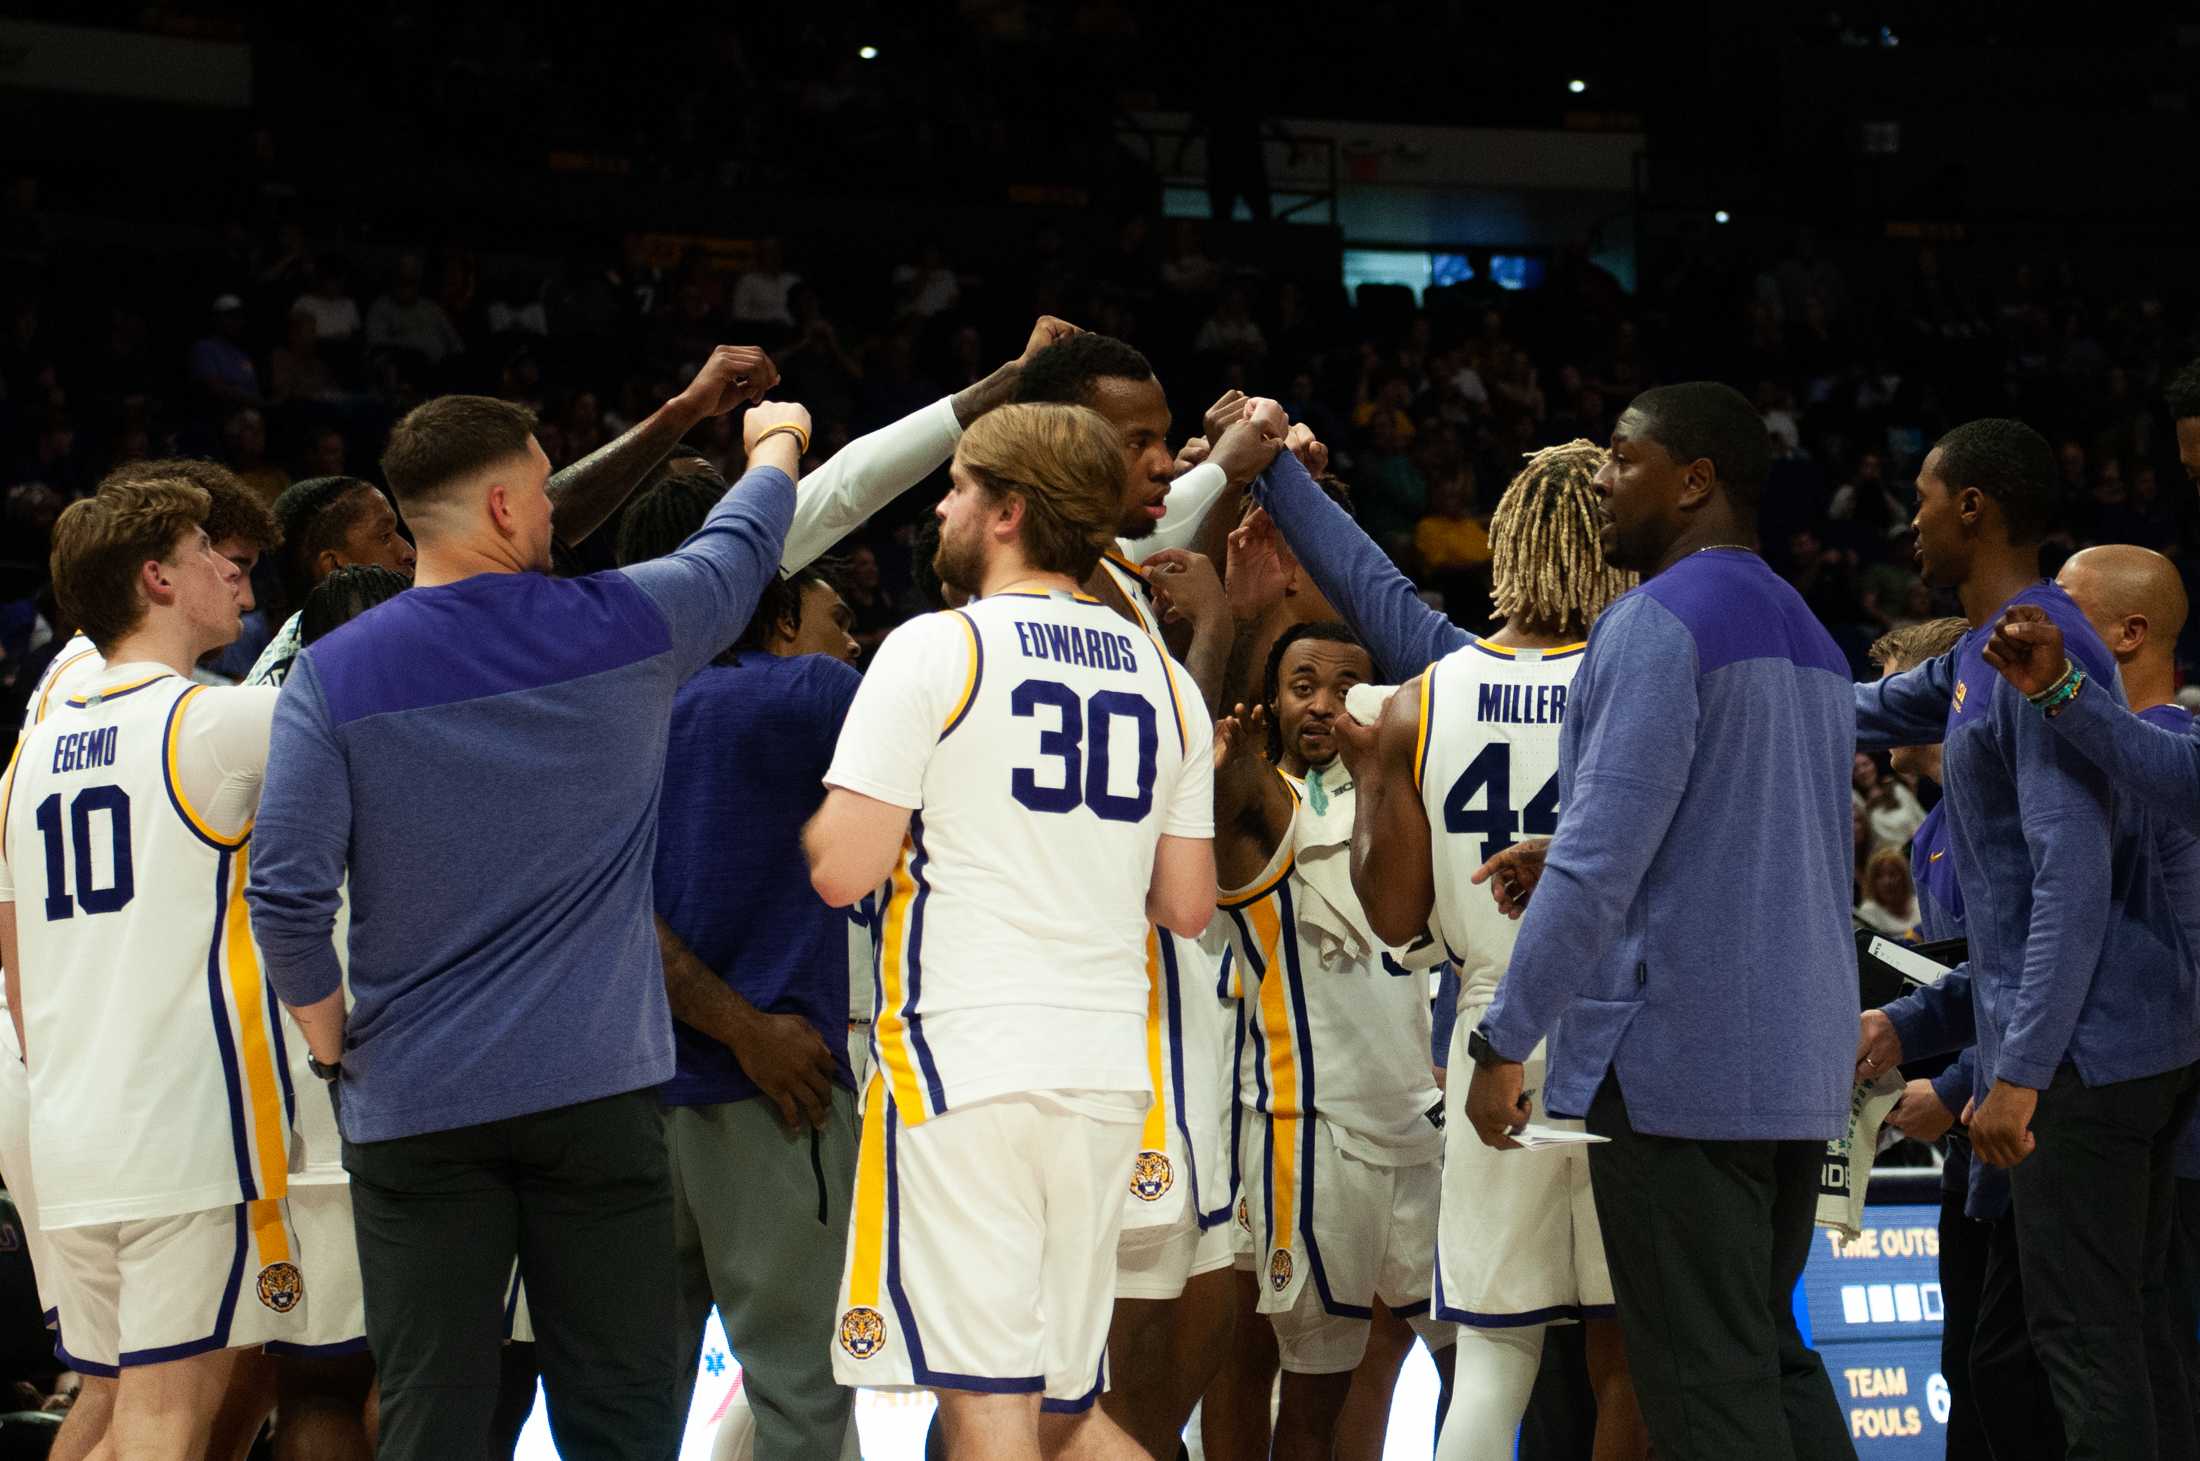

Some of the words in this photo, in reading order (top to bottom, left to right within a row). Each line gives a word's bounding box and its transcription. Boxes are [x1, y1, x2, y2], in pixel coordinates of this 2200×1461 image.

[1014, 621, 1138, 673] EDWARDS
[1477, 683, 1568, 724] MILLER
[52, 726, 118, 774] EGEMO
[1011, 679, 1158, 823] 30
[36, 784, 135, 921] 10
[1881, 1228, 1939, 1257] OUTS
[1844, 1367, 1908, 1397] TEAM
[1926, 1372, 1951, 1424] 6
[1850, 1406, 1921, 1438] FOULS
